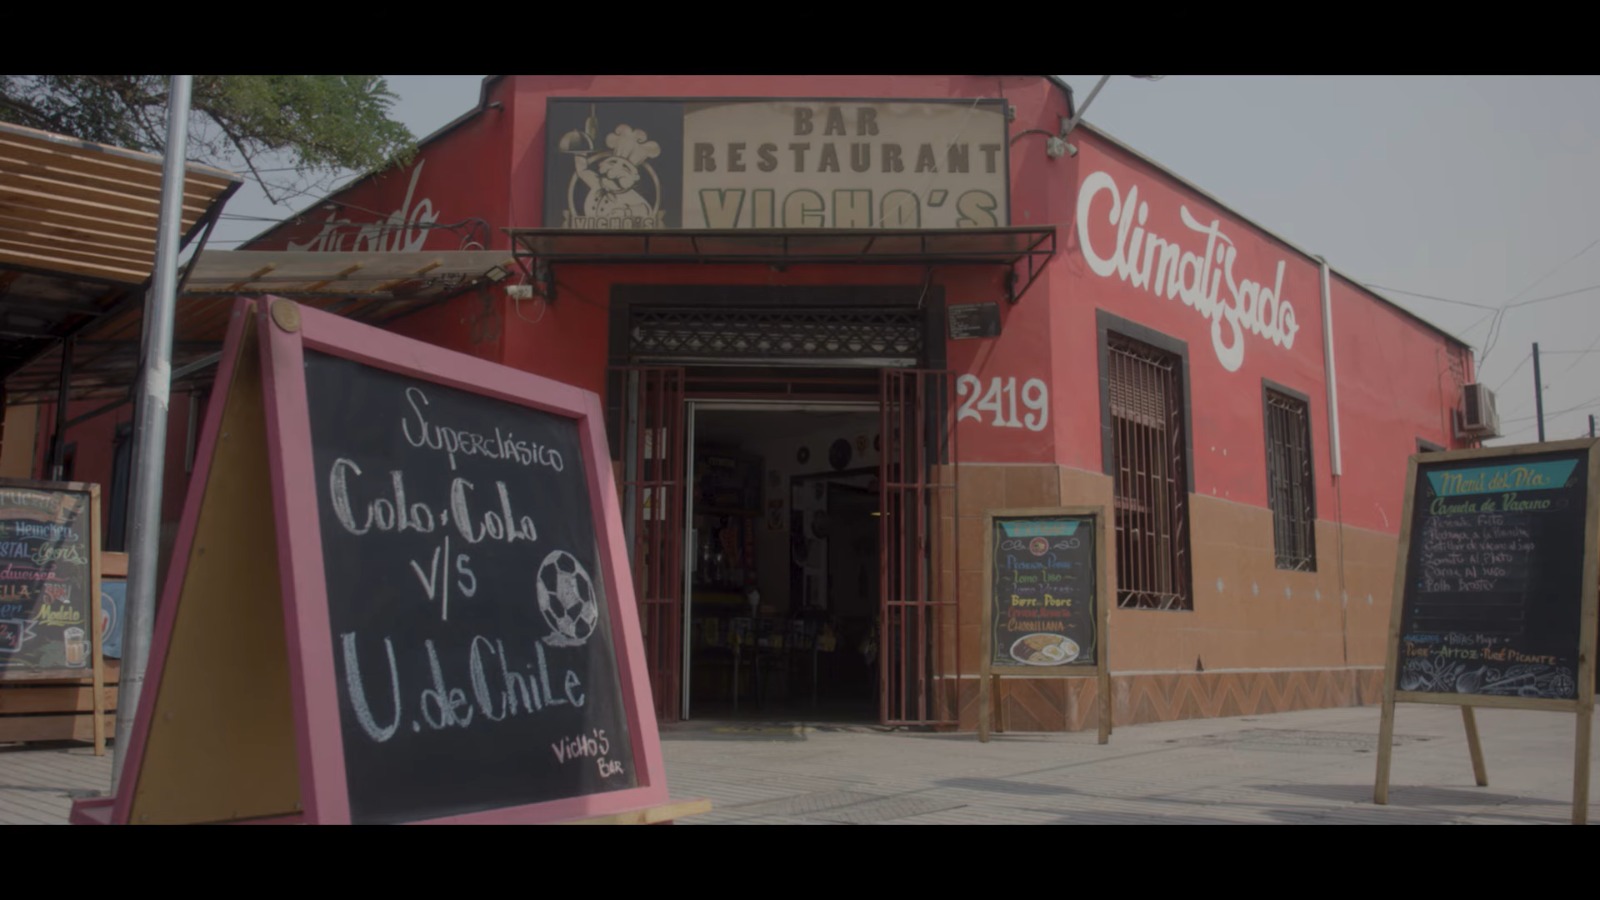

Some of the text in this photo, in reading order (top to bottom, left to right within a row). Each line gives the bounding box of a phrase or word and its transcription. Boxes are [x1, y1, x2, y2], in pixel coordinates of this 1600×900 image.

[793, 106, 879, 137] BAR
[694, 142, 1003, 174] RESTAURANT
[698, 188, 999, 229] VICHO'S
[1076, 170, 1300, 373] Climatizado
[956, 373, 1049, 432] 2419
